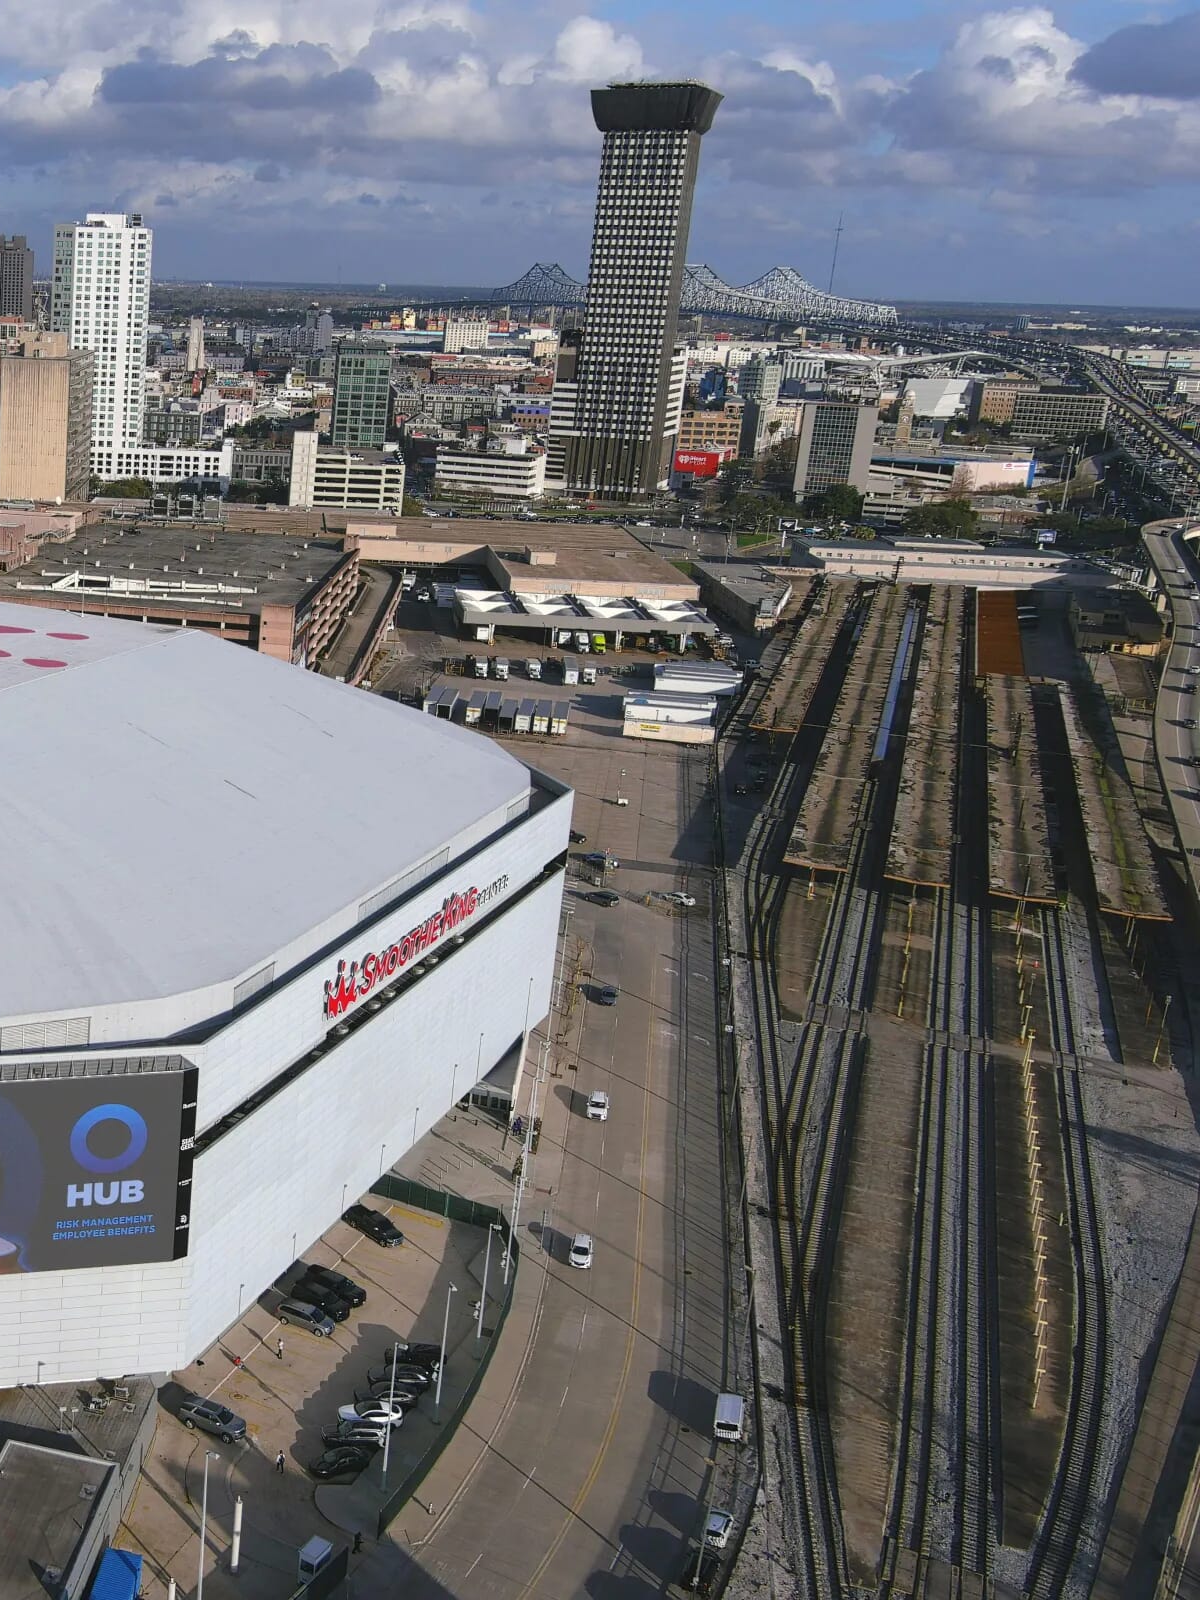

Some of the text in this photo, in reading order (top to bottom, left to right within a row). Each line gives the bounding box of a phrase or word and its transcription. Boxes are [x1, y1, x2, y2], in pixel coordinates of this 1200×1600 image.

[360, 912, 442, 996] SMOOTHIE
[66, 1179, 145, 1208] HUB
[52, 1225, 156, 1240] EMPLOYEE BENEFITS
[56, 1214, 154, 1229] RISK MANAGEMENT
